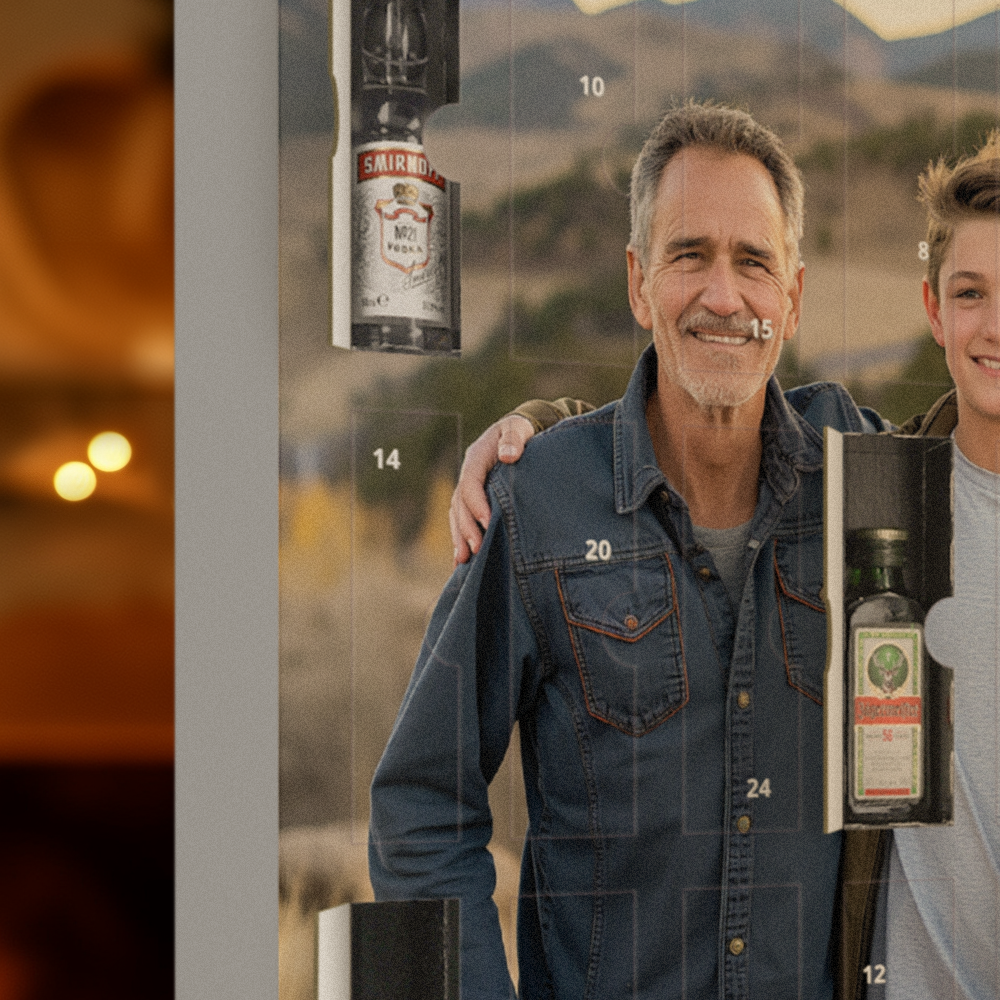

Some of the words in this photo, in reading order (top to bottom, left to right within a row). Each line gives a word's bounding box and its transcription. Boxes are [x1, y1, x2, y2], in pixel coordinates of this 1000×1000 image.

[580, 75, 605, 98] 10
[917, 241, 929, 261] 8
[750, 318, 774, 340] 15
[373, 447, 401, 470] 14
[585, 539, 612, 561] 20
[746, 777, 772, 799] 24
[863, 965, 886, 984] 12
